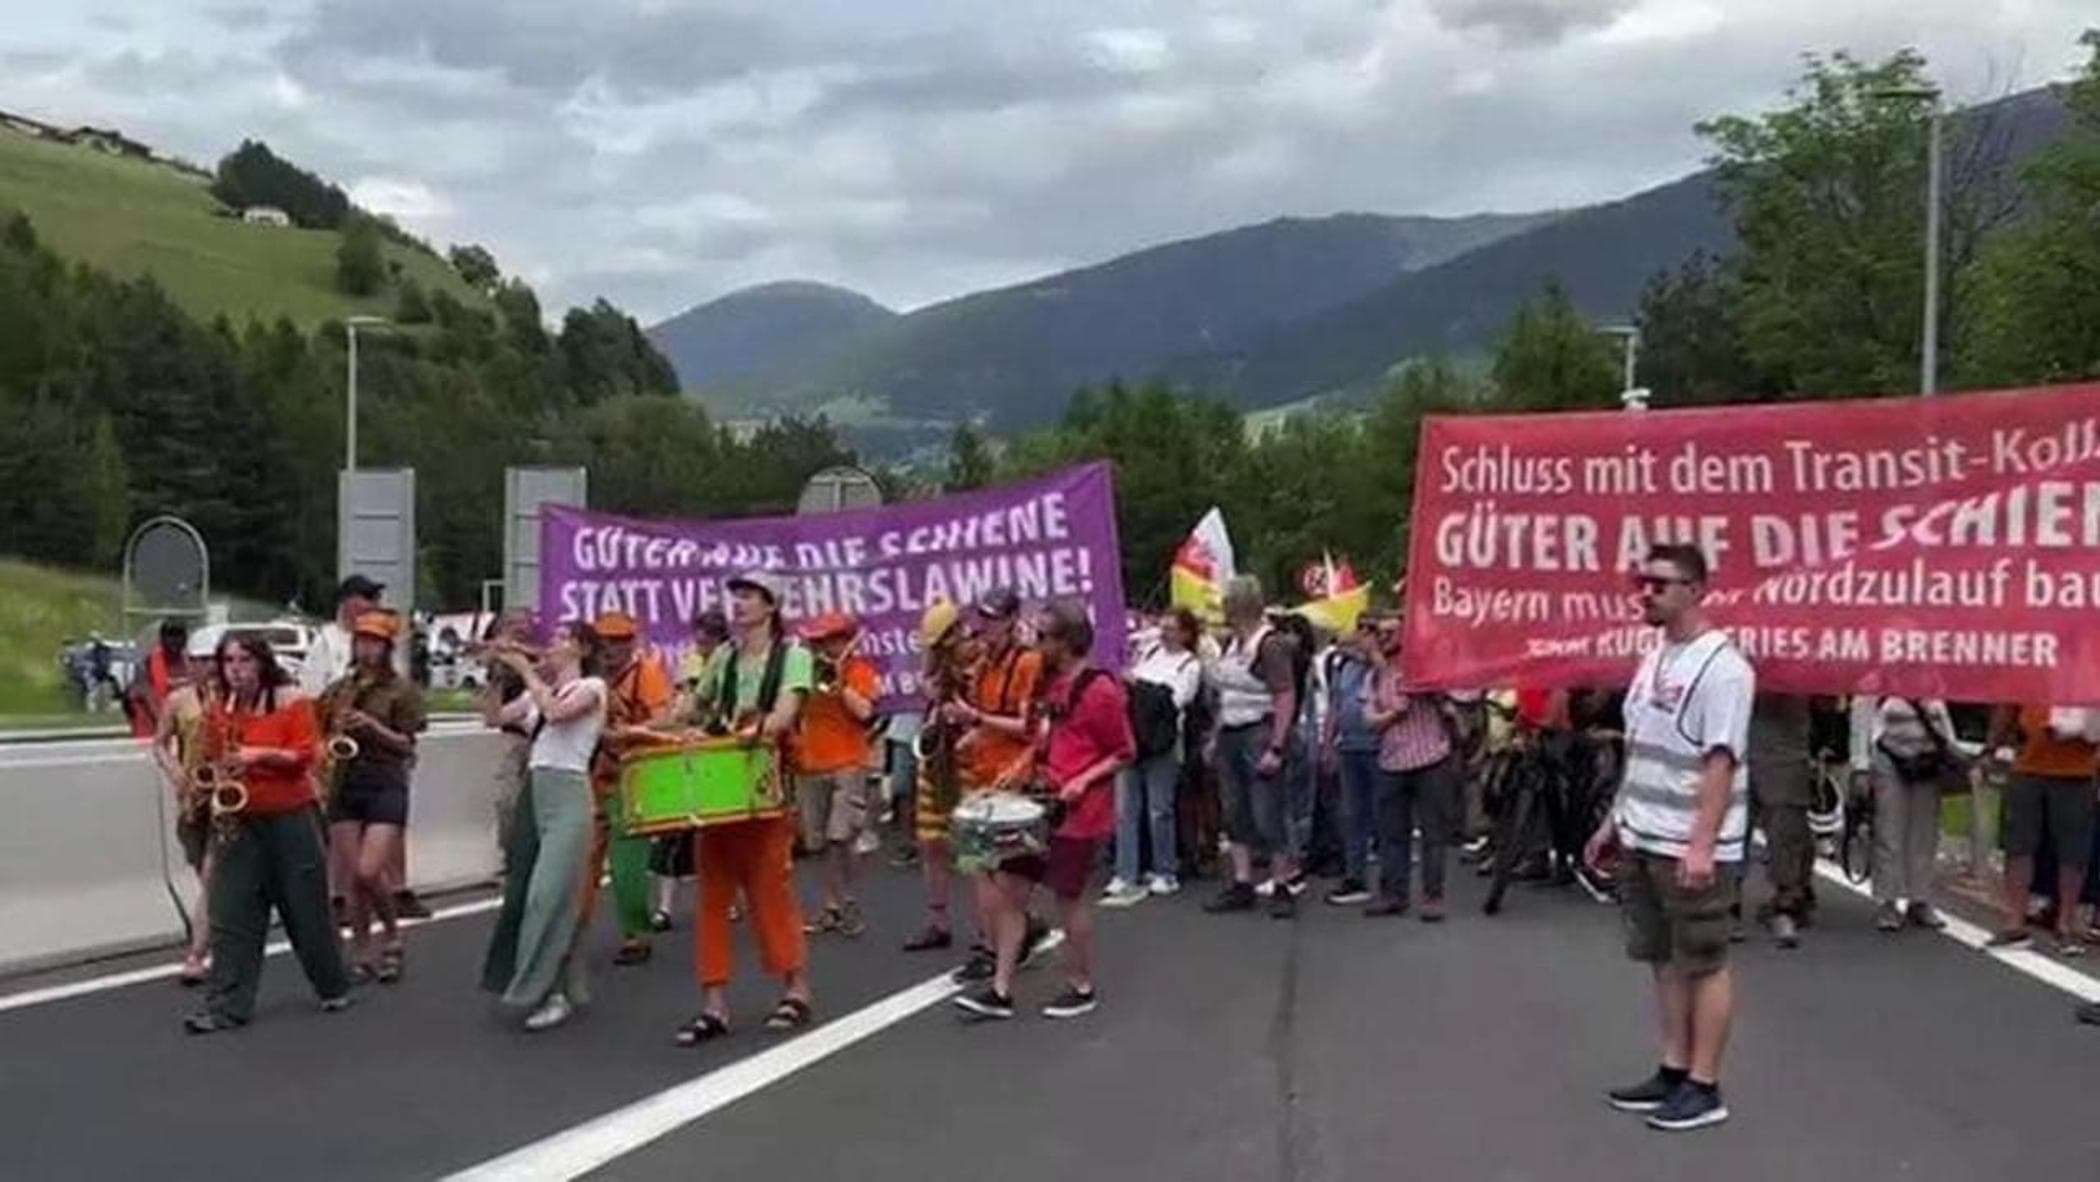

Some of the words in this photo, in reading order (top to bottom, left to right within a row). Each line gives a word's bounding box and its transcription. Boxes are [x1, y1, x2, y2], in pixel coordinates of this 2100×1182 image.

[1440, 442, 1573, 494] Schluss
[1584, 445, 1658, 494] mit
[1670, 441, 1773, 494] dem
[1784, 416, 2100, 492] Transit-Koll
[573, 526, 699, 570] GÜTER
[797, 538, 866, 570] DIE
[1436, 500, 1600, 572] GÜTER
[1751, 512, 1860, 568] DIE
[559, 579, 663, 624] STATT
[1433, 575, 1549, 629] Bayern
[1817, 631, 1869, 661] AM
[1880, 632, 2058, 667] BRENNER
